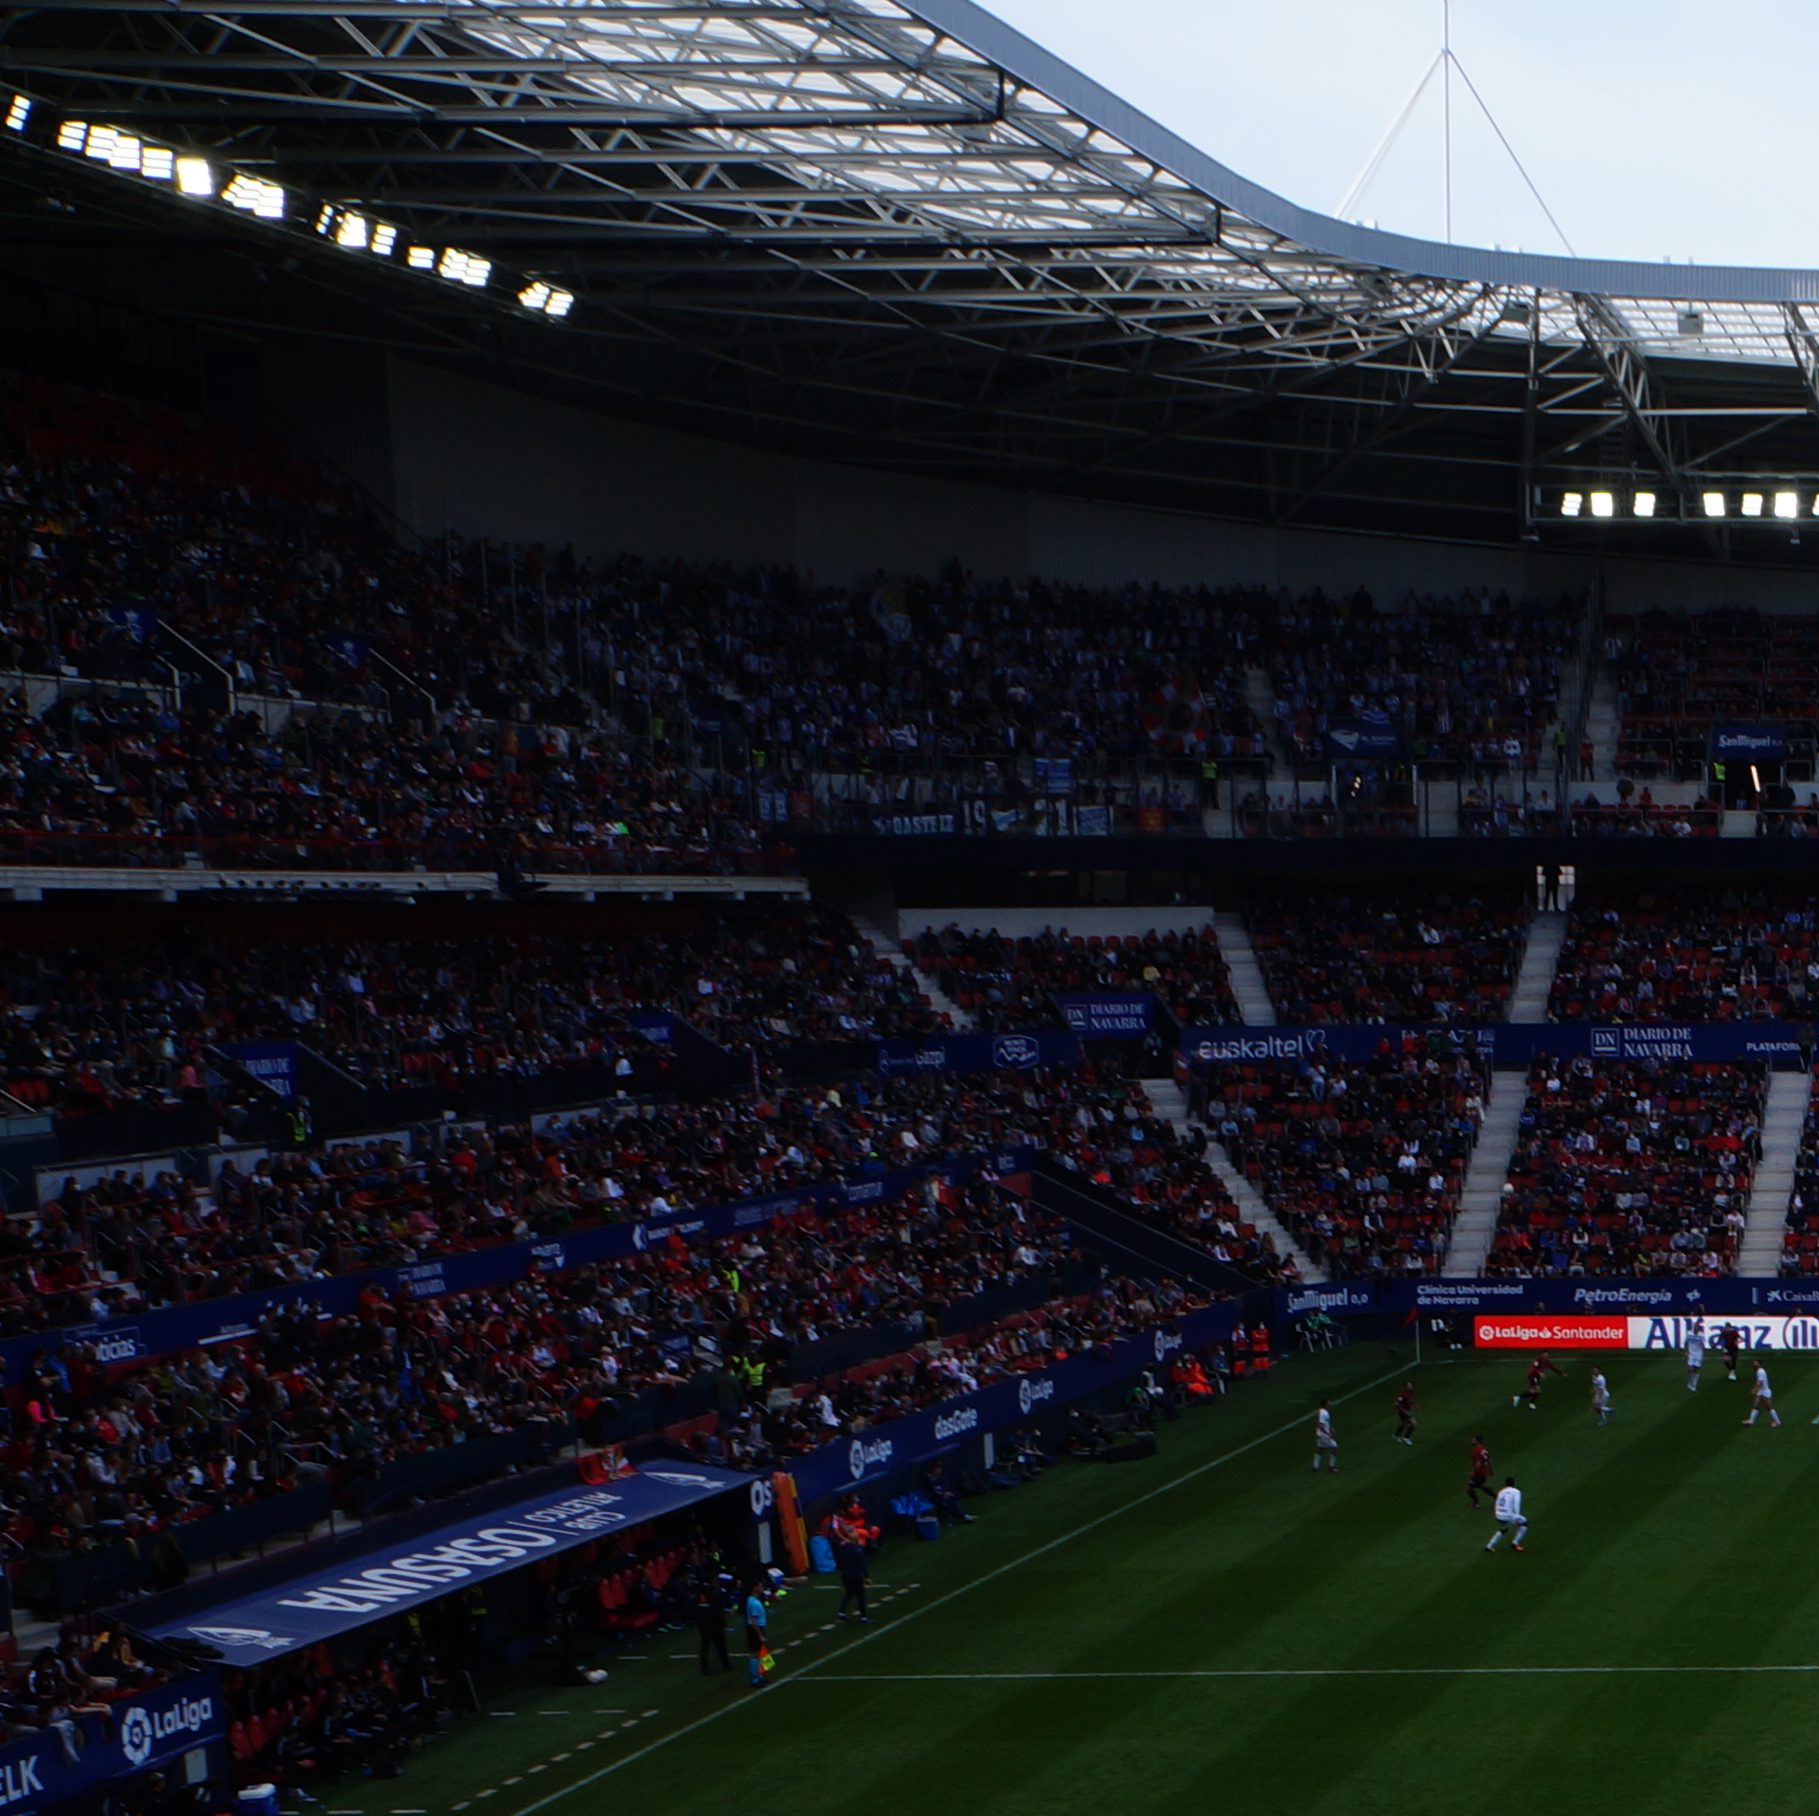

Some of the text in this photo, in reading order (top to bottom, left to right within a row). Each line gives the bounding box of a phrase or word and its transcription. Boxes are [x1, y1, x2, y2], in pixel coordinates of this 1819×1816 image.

[1090, 1003, 1146, 1015] DIARIO DE
[1090, 1017, 1147, 1030] NAVARRA
[1594, 1032, 1616, 1046] DN
[1623, 1027, 1692, 1041] DIARIO DE
[1198, 1034, 1303, 1060] euskaltel
[1623, 1042, 1694, 1058] NAVARRA
[1416, 1283, 1524, 1295] Clínica Universidad
[1416, 1295, 1480, 1305] de Navarra
[1574, 1288, 1673, 1305] PetroEnergía
[1494, 1325, 1625, 1340] LaLiga Santander
[276, 1527, 558, 1614] OSASUNA
[152, 1697, 213, 1740] LaLiga
